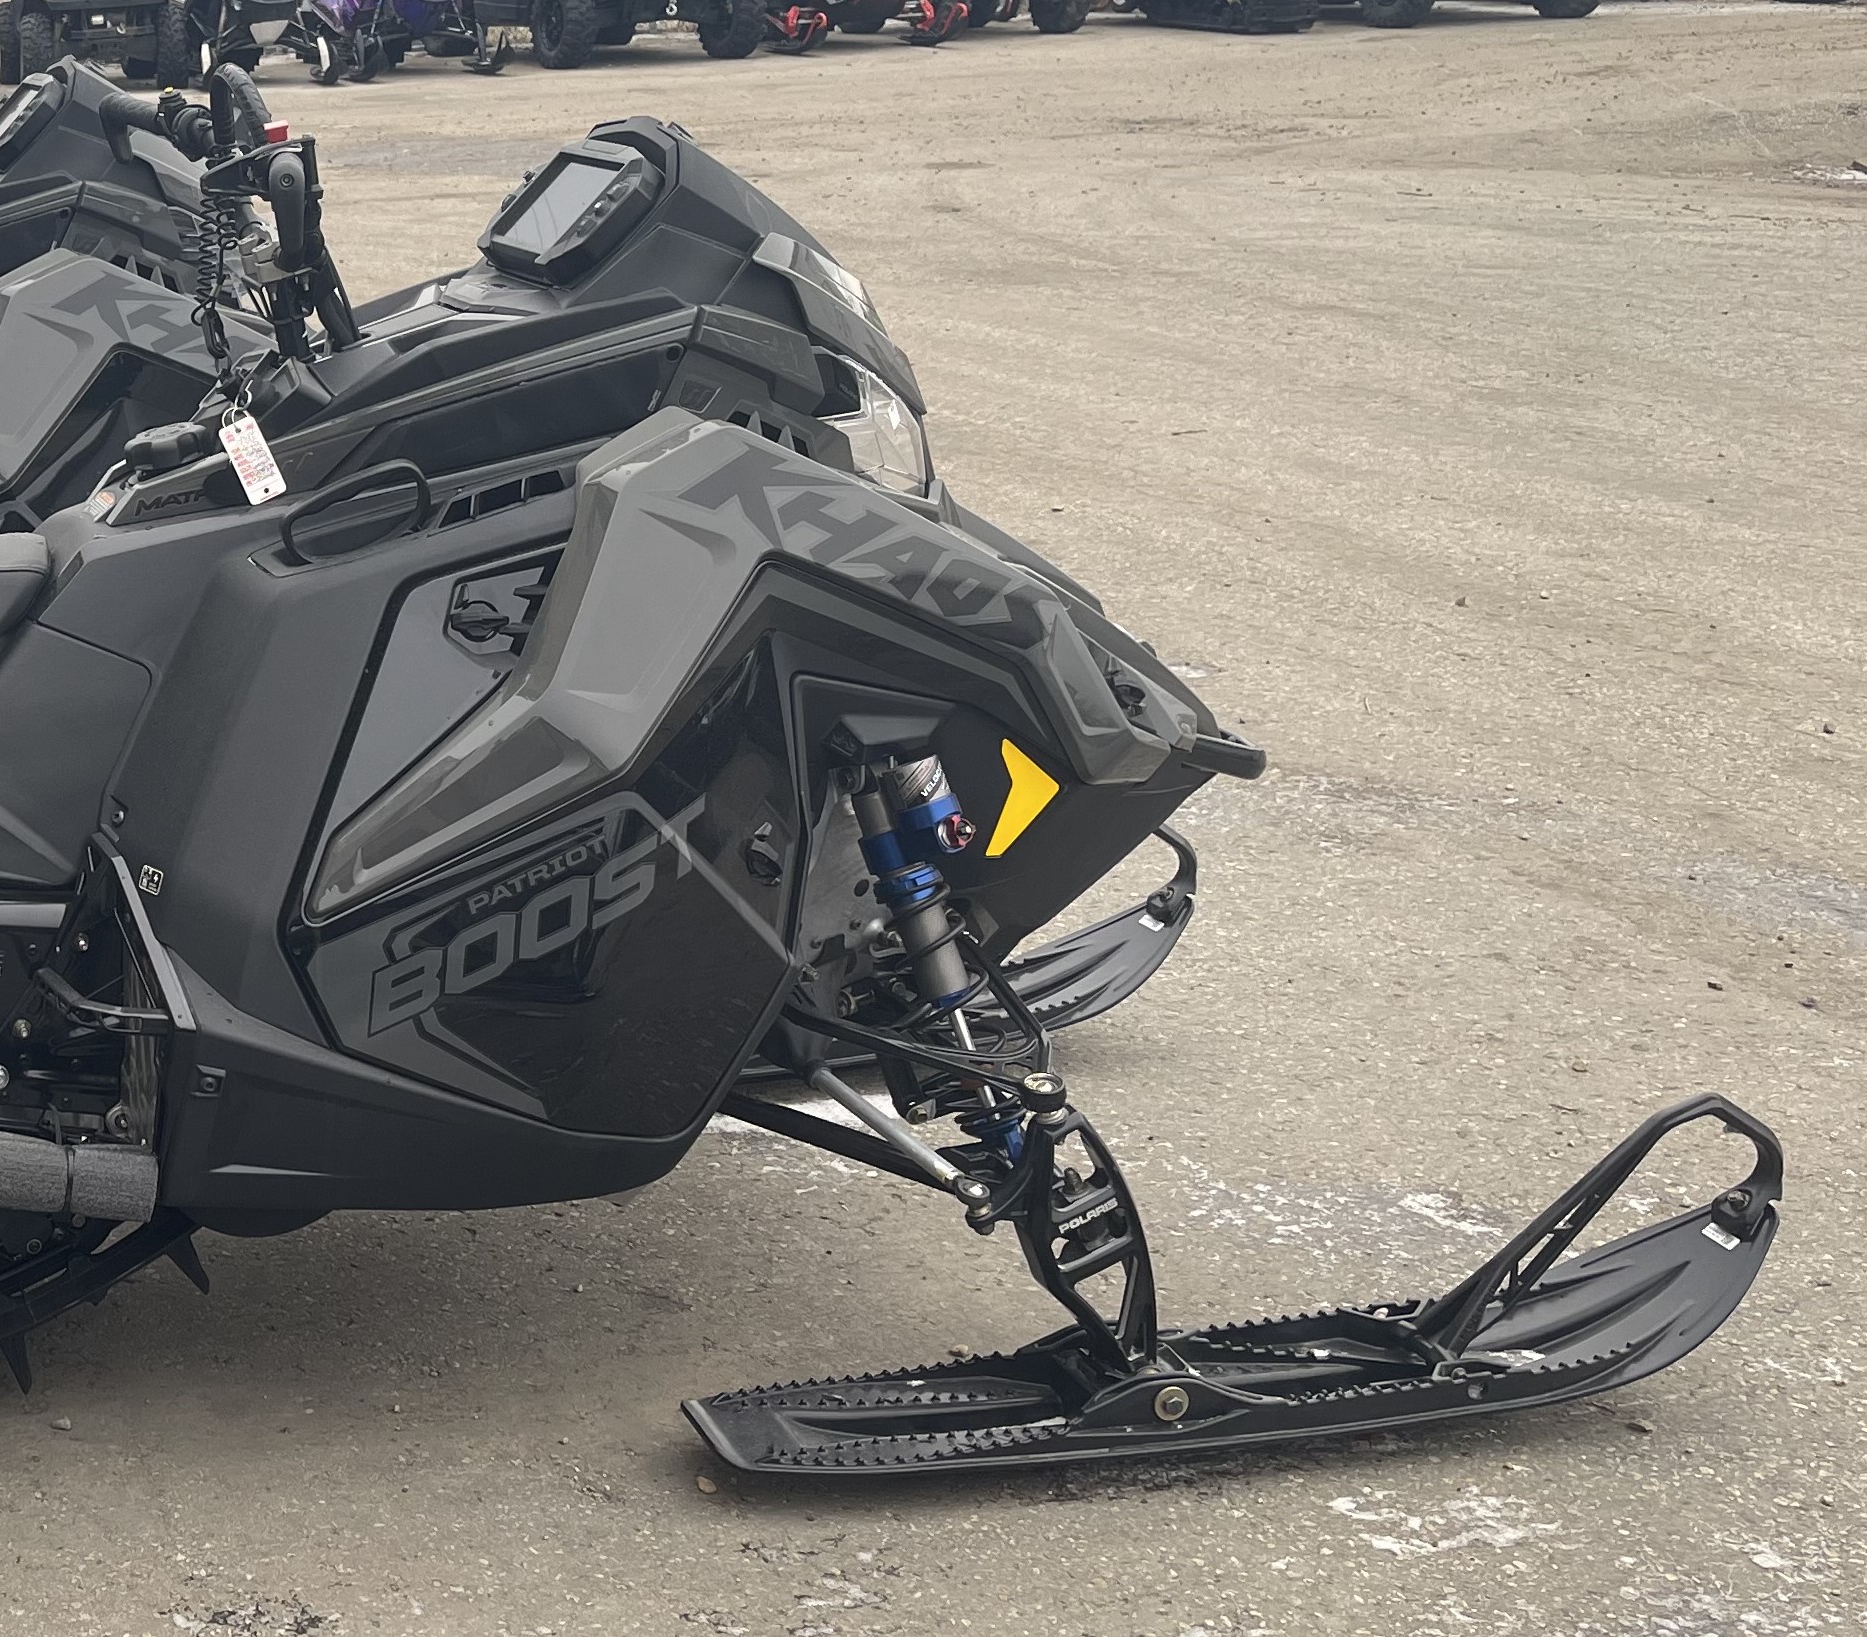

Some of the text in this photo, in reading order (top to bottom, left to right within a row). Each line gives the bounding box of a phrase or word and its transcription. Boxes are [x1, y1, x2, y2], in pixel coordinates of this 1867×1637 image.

[368, 793, 708, 1038] BOOST
[466, 833, 609, 917] PATRIOT
[1058, 1196, 1119, 1235] POLARIS
